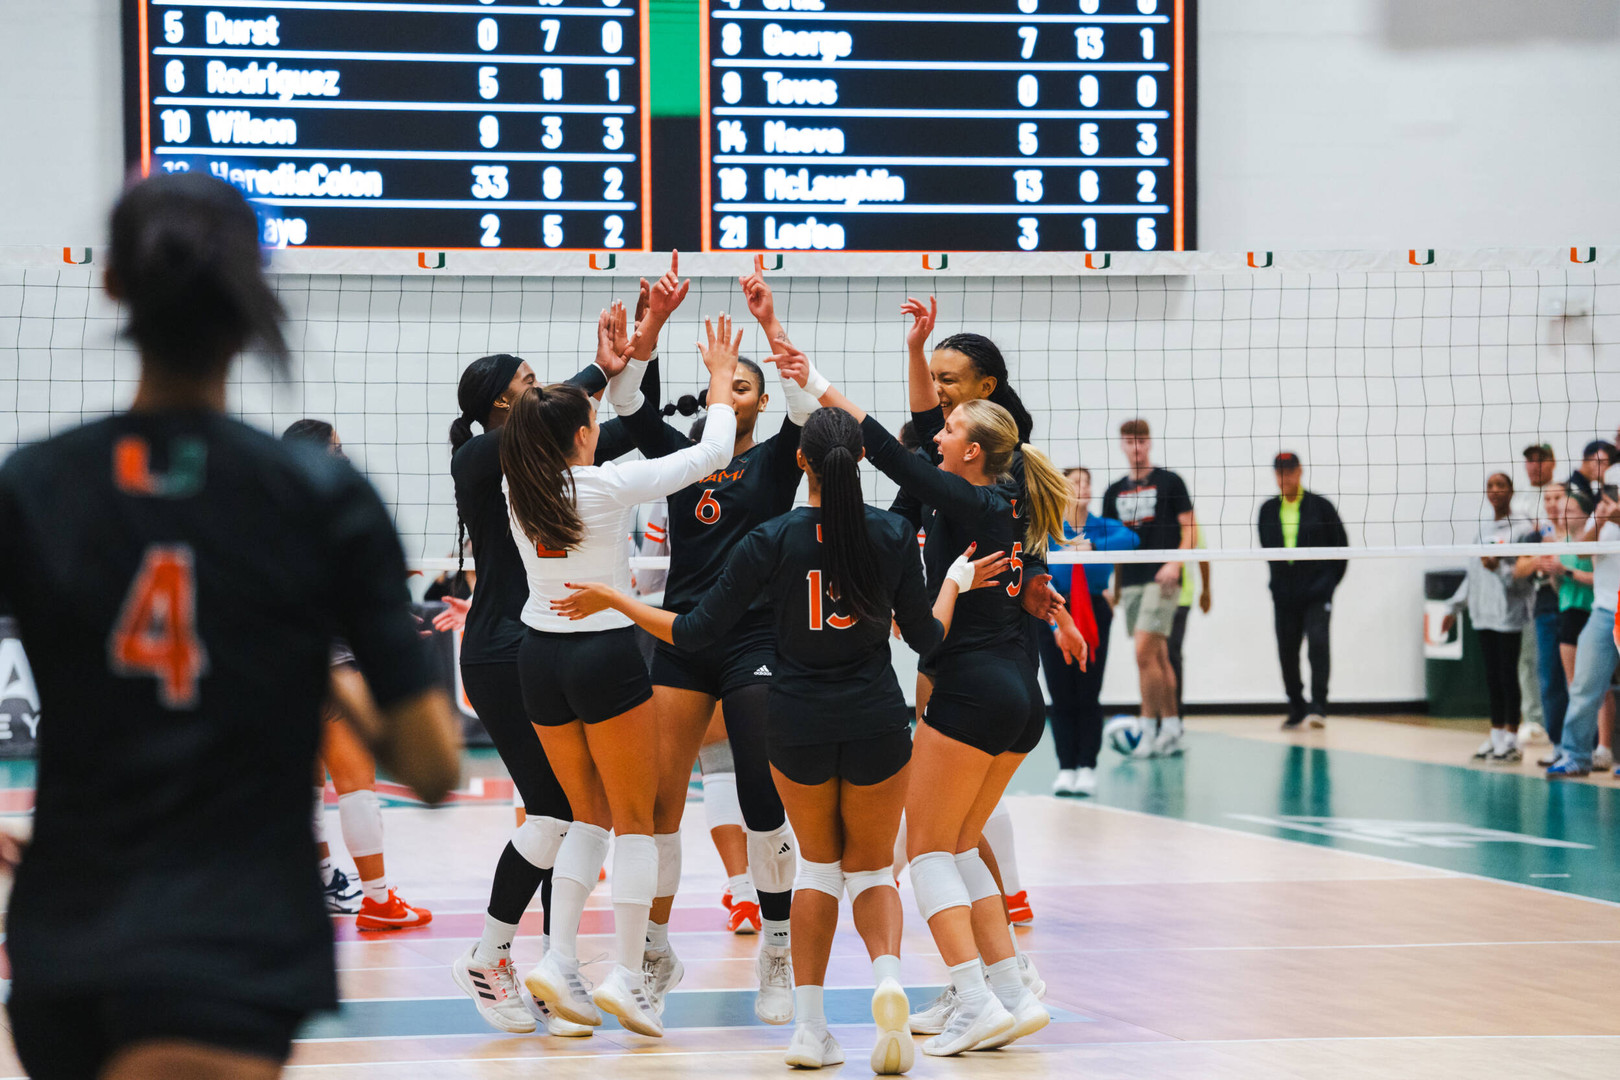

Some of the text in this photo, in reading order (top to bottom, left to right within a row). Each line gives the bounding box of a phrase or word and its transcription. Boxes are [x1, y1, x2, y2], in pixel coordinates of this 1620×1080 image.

[165, 11, 622, 53] 5 Durst 0 7 0
[722, 23, 1153, 62] 8 George 7 13 1
[166, 60, 619, 102] 6 Rodriguez 5 11 1
[722, 72, 741, 103] 9
[1018, 75, 1037, 106] 0
[1080, 75, 1098, 107] 9
[1137, 76, 1156, 107] 0
[161, 110, 623, 149] 10 Wilson 9 3 3
[718, 121, 747, 152] 14
[1019, 123, 1037, 155] 5
[1080, 123, 1098, 155] 5
[1137, 124, 1157, 155] 3
[472, 166, 508, 198] 33
[543, 167, 562, 199] 8
[604, 168, 623, 200] 2
[765, 168, 905, 206] McLaughlin
[1014, 170, 1042, 202] 13
[1138, 171, 1156, 202] 2
[262, 214, 624, 249] aye 2 5 2
[720, 216, 747, 248] 21
[1019, 218, 1038, 250] 3
[1083, 218, 1095, 250] 1
[1138, 218, 1156, 250] 5
[63, 247, 92, 264] U
[418, 252, 445, 269] U
[589, 254, 616, 270] U
[758, 254, 783, 270] U
[922, 254, 948, 270] U
[1085, 253, 1111, 269] U
[1247, 252, 1273, 268] U
[1409, 249, 1435, 265] U
[1570, 247, 1597, 263] U
[113, 436, 207, 496] U
[699, 469, 745, 483] AMI
[695, 489, 721, 525] 6
[1006, 542, 1023, 597] 5
[107, 541, 210, 711] 4
